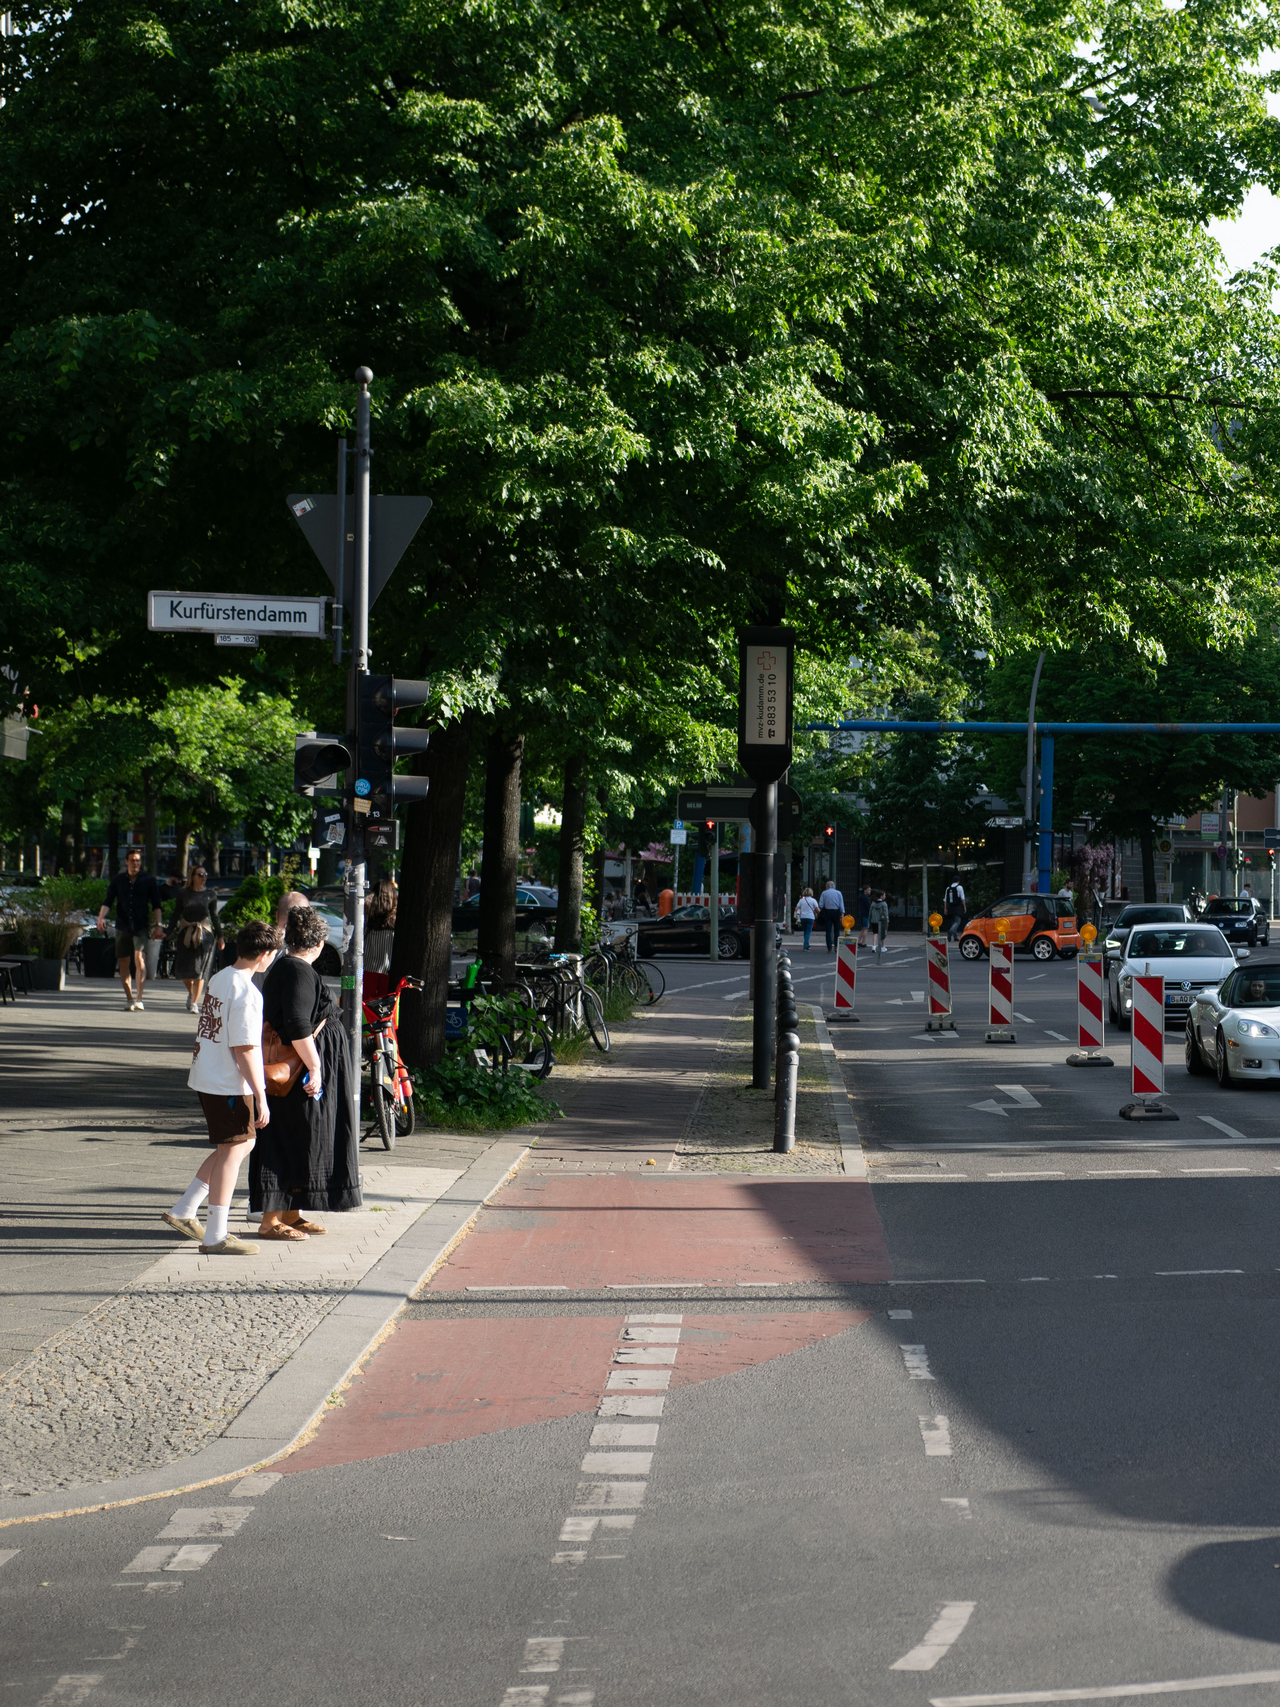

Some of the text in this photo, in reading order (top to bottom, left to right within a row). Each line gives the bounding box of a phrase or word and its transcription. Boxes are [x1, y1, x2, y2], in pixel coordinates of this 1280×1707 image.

[170, 600, 307, 623] Kurfürstendamm
[757, 673, 765, 738] mvz-kudamm.de
[767, 674, 776, 726] 883 53 10
